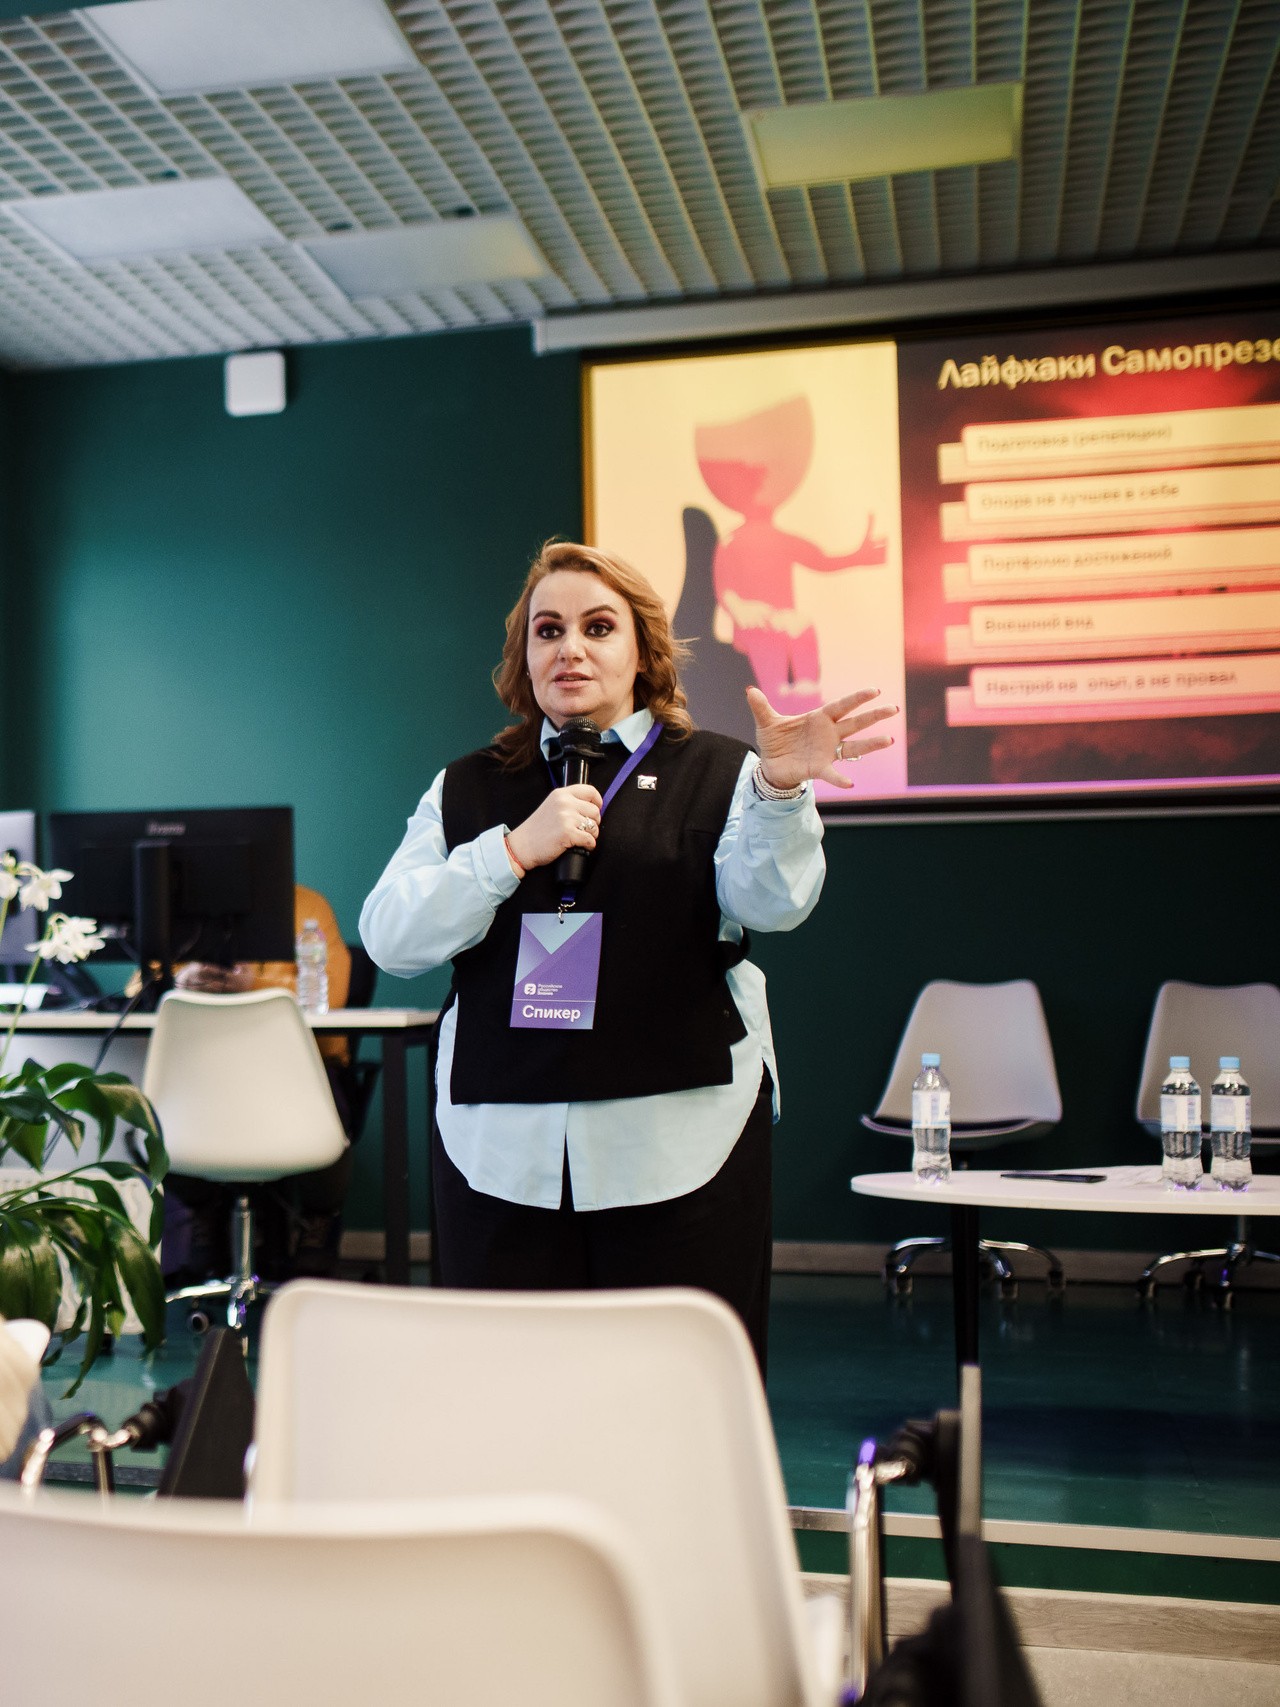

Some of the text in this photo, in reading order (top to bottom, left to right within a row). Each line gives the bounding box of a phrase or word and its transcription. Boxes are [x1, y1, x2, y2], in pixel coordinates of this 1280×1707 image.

[938, 354, 1097, 390] Лайфхаки
[985, 614, 1094, 634] Внешний вид
[1176, 671, 1238, 689] провал
[522, 1005, 581, 1022] Спикер
